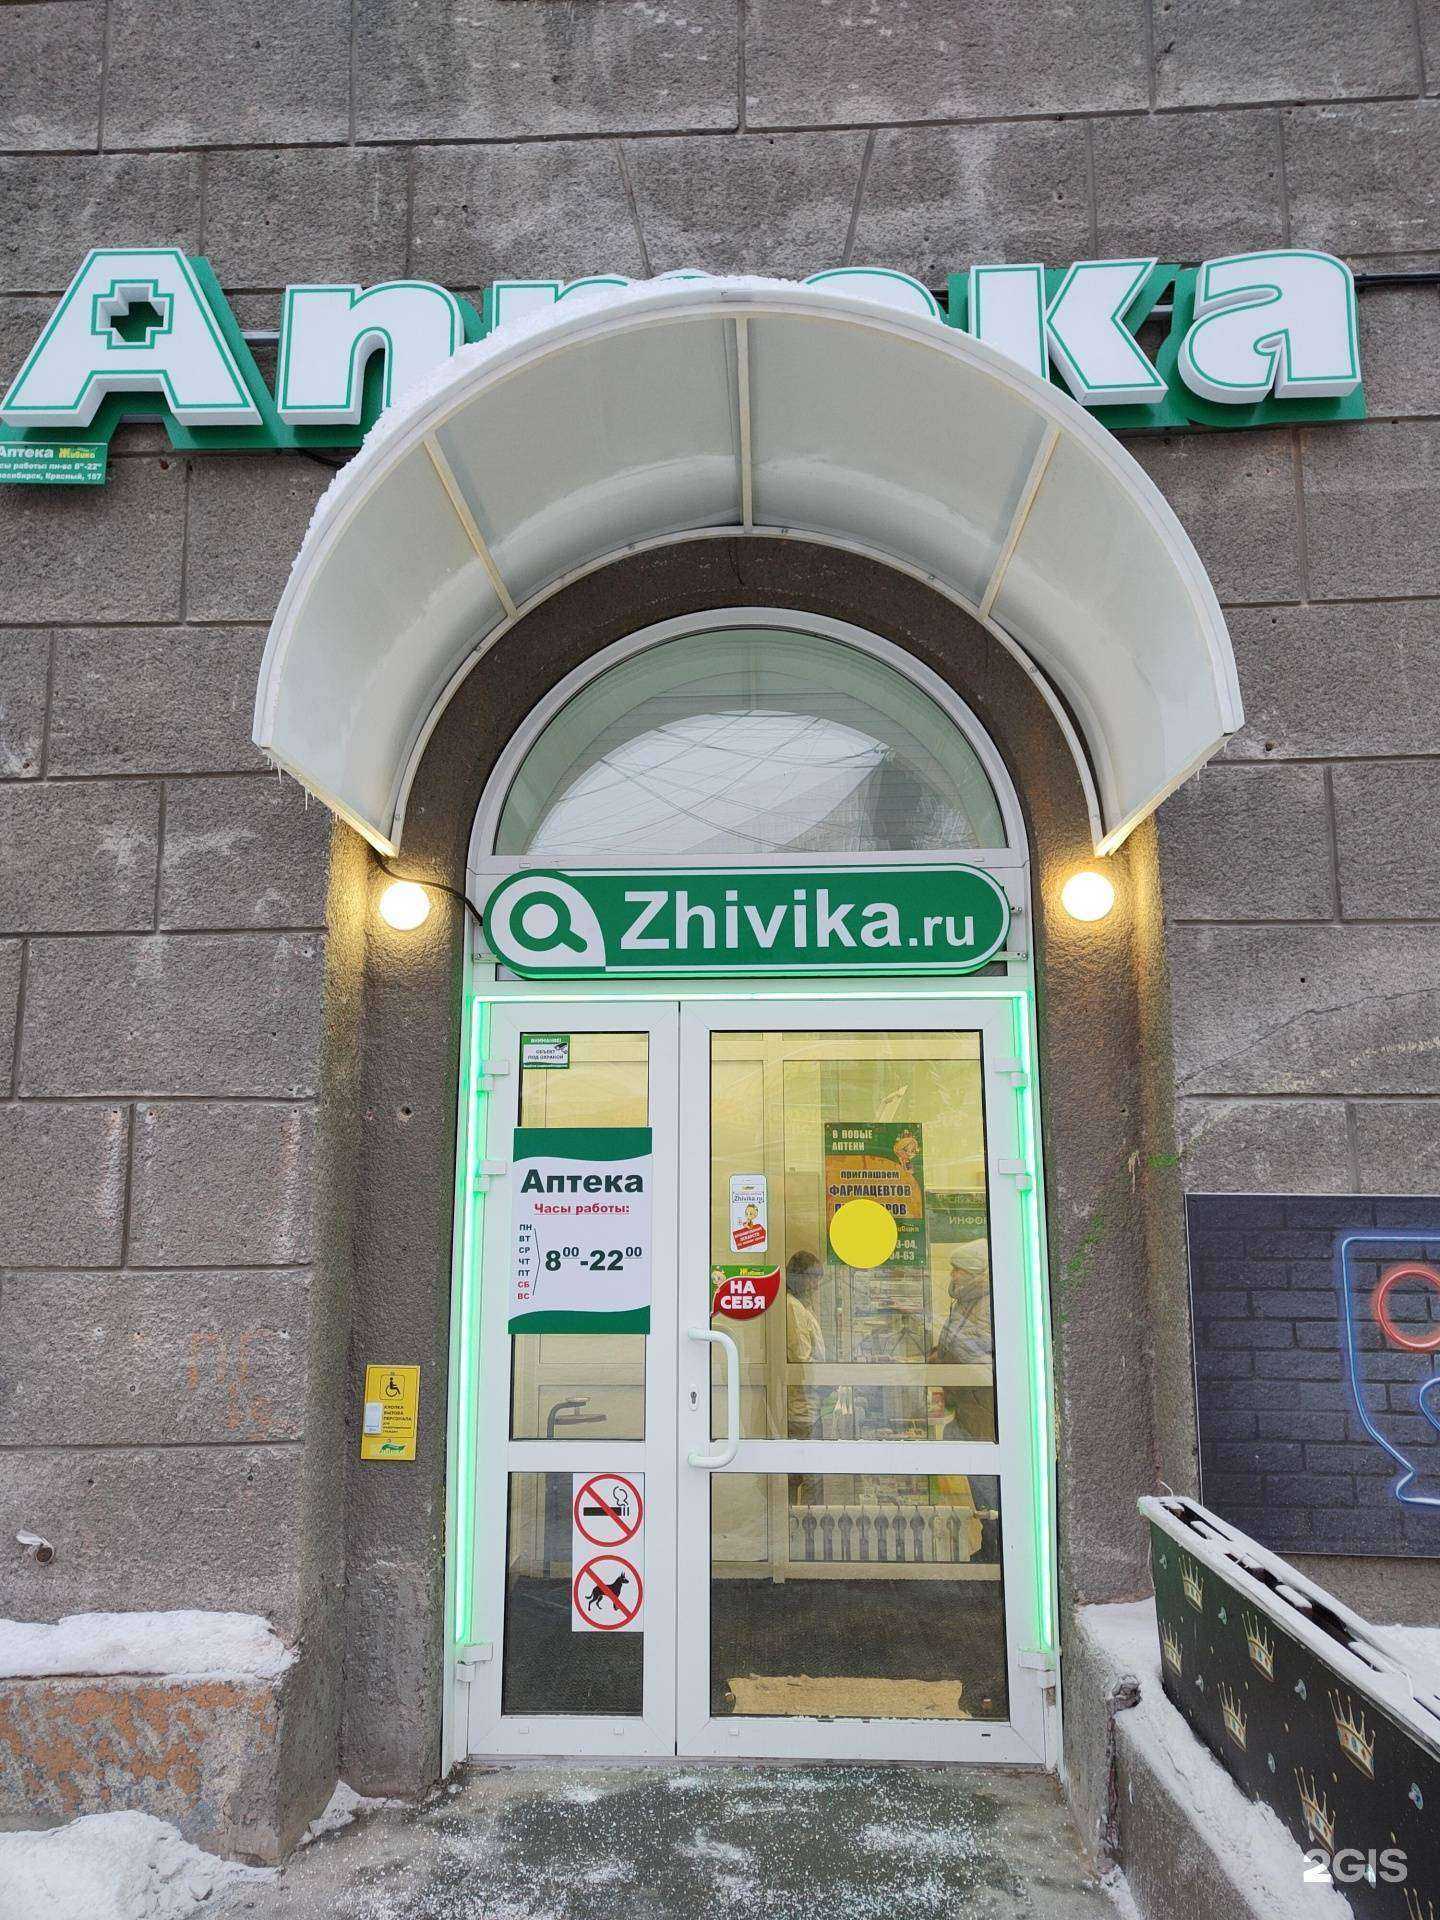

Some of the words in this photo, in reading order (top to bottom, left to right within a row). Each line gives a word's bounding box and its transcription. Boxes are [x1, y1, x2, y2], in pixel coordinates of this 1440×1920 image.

[0, 247, 1362, 427] Апка
[0, 446, 53, 458] Аптека
[620, 888, 975, 950] Zhivika.ru
[842, 1130, 873, 1139] НОВЫЕ
[841, 1170, 900, 1179] приглашаем
[520, 1169, 644, 1193] Аптека
[829, 1184, 911, 1198] ФАРМАЦЕВТОВ
[534, 1203, 571, 1214] Часы
[575, 1203, 630, 1215] работы:
[519, 1223, 532, 1231] ПН
[518, 1246, 531, 1254] СР
[518, 1257, 531, 1265] ЧТ
[518, 1269, 530, 1277] ПТ
[730, 1280, 756, 1294] НА
[517, 1292, 530, 1300] ВС
[720, 1295, 766, 1310] СЕБЯ
